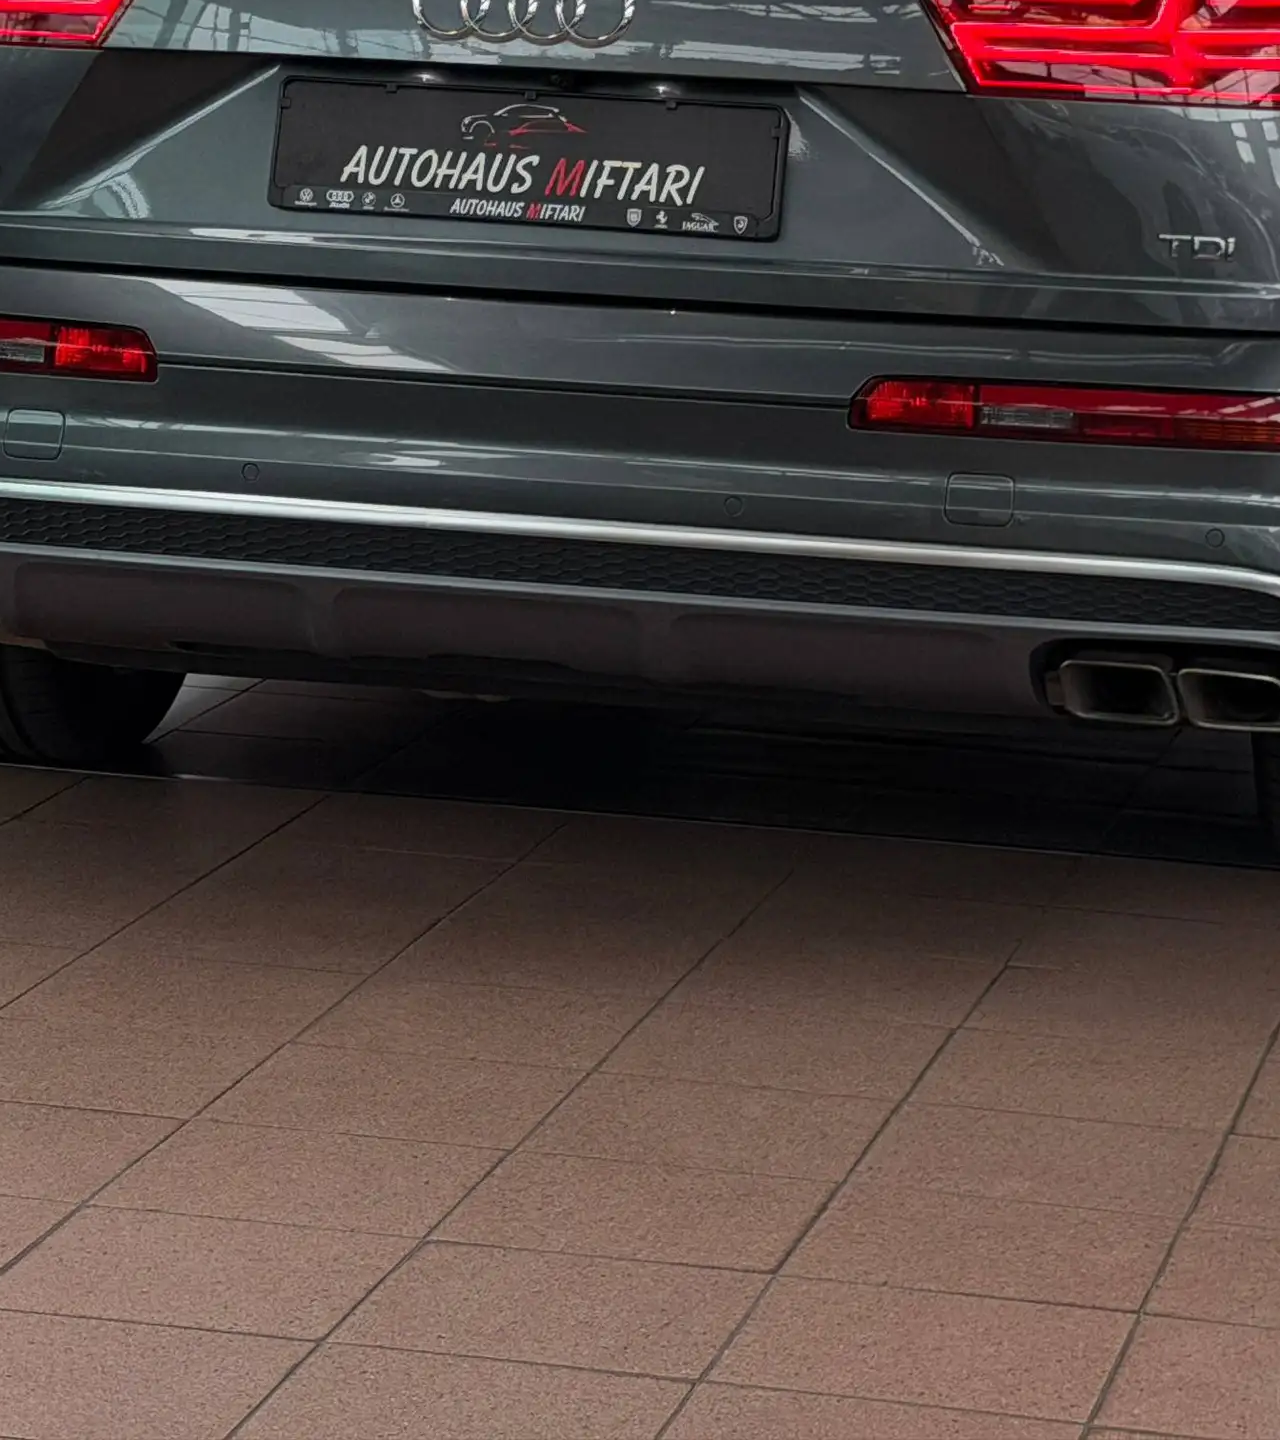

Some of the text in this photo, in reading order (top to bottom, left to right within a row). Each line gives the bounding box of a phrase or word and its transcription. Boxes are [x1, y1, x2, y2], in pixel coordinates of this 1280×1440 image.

[339, 144, 706, 207] AUTOHAUS MIFTARI
[449, 197, 587, 222] AUTOHAUS MIFTARI
[1158, 233, 1236, 259] TDI
